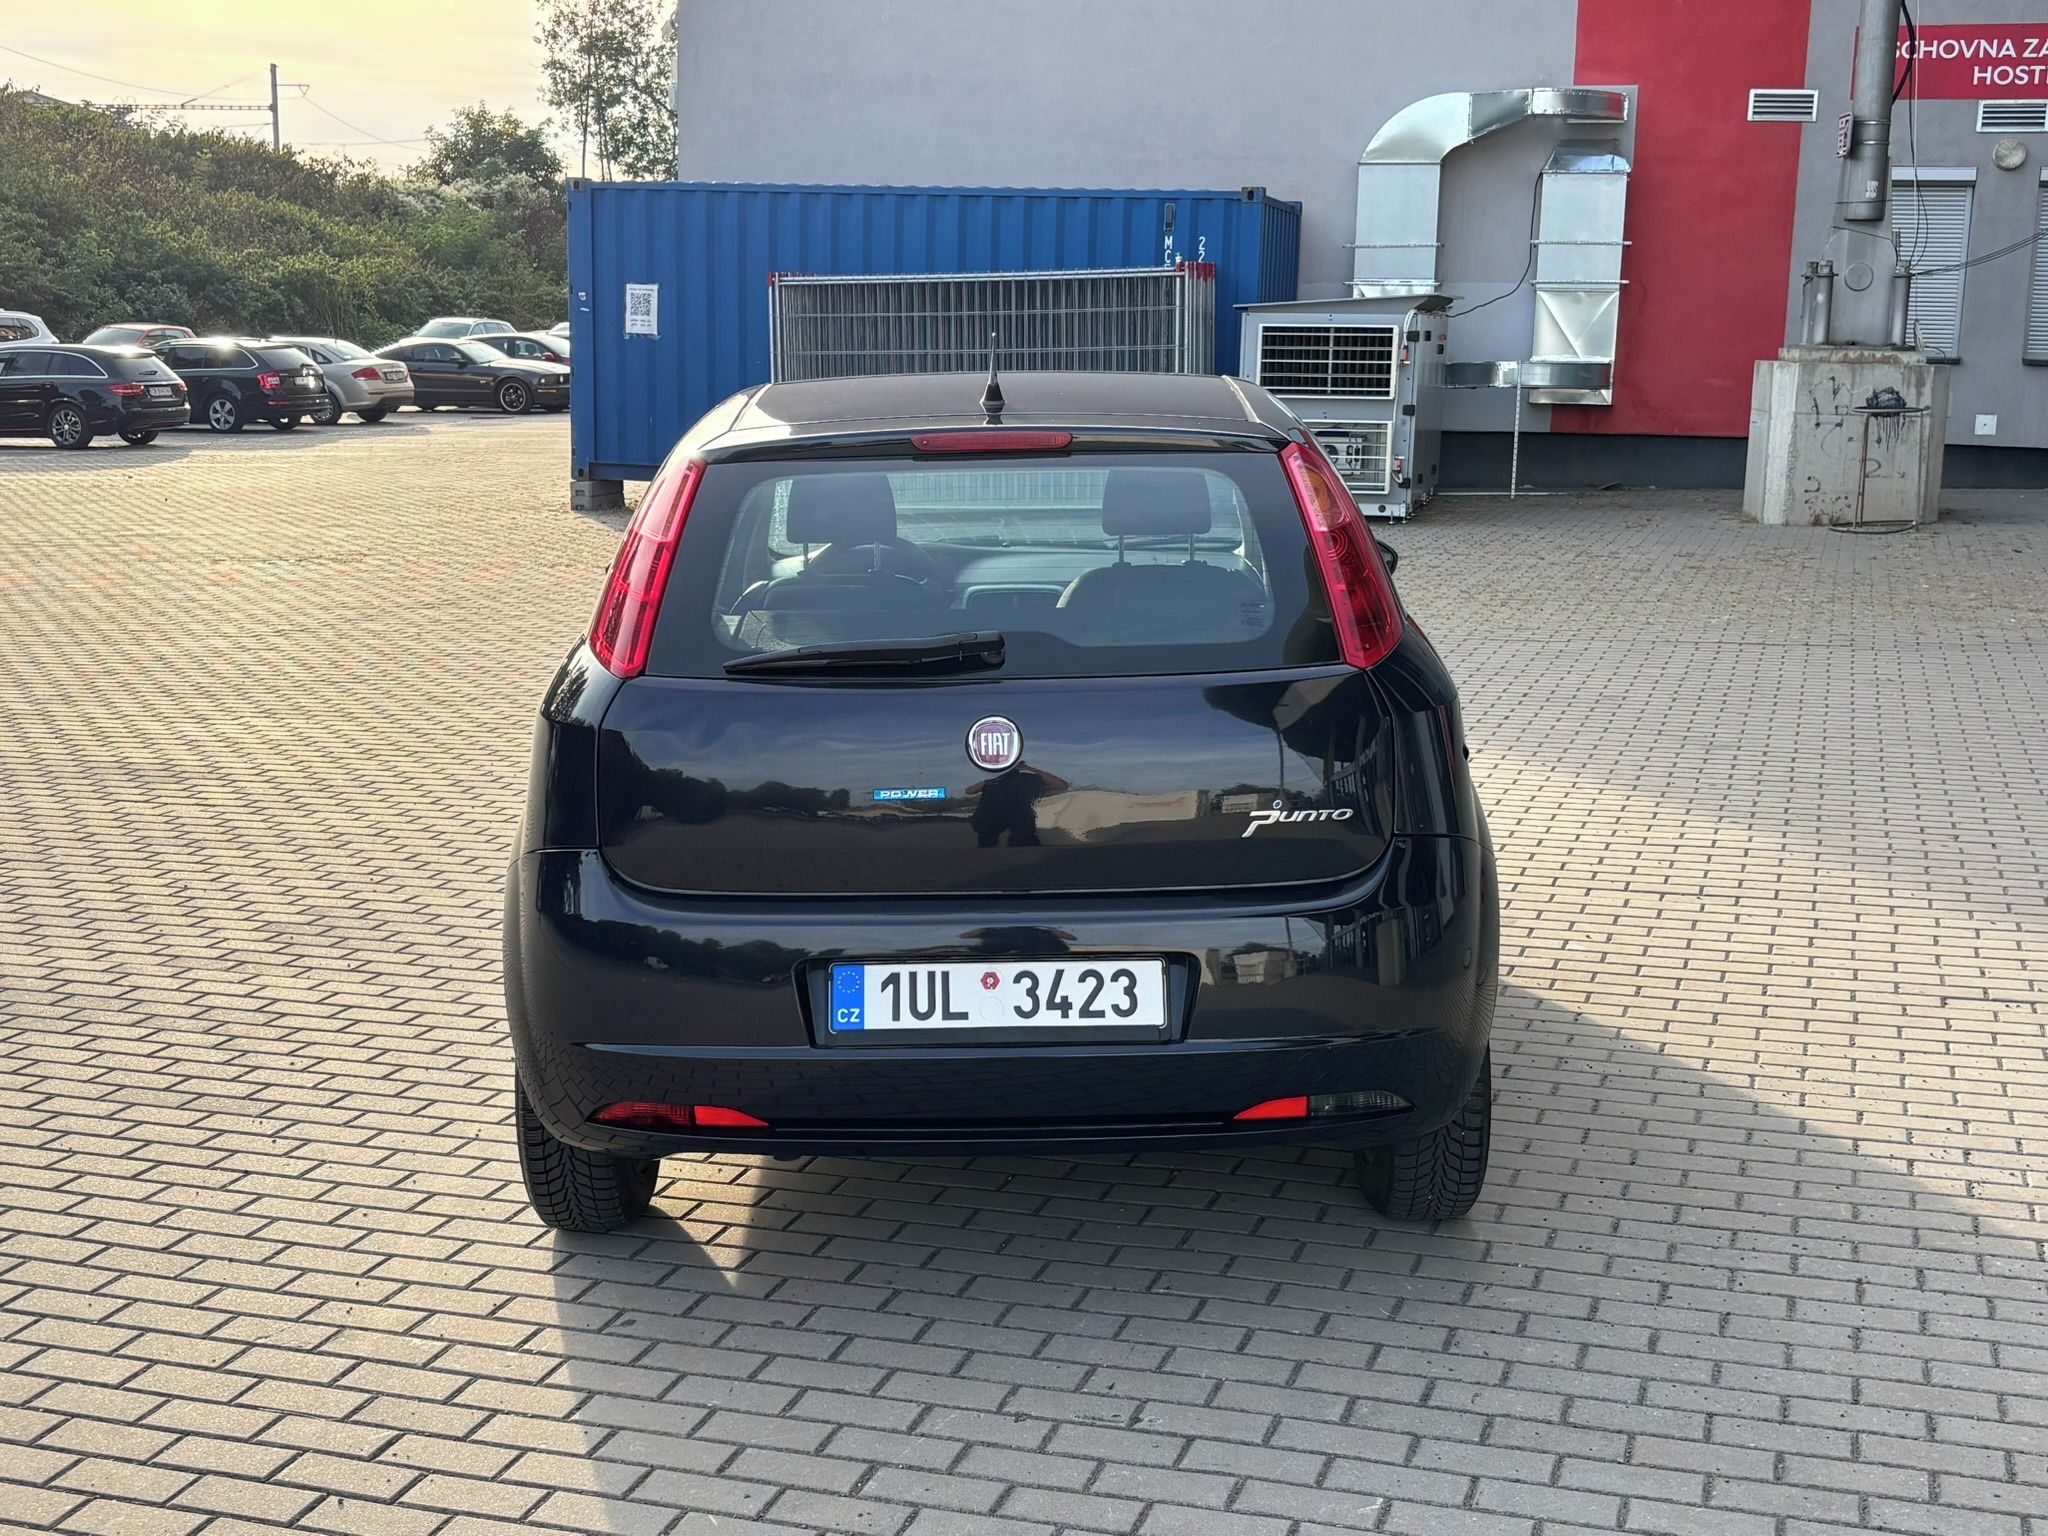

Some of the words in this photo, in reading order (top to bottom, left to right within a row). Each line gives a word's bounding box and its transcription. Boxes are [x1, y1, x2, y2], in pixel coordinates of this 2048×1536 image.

[1972, 65, 2048, 86] HOST
[980, 732, 1010, 756] FIAT
[880, 789, 939, 799] POWER
[880, 970, 969, 1022] 1UL
[1012, 968, 1138, 1020] 3423
[837, 1008, 860, 1023] CZ
